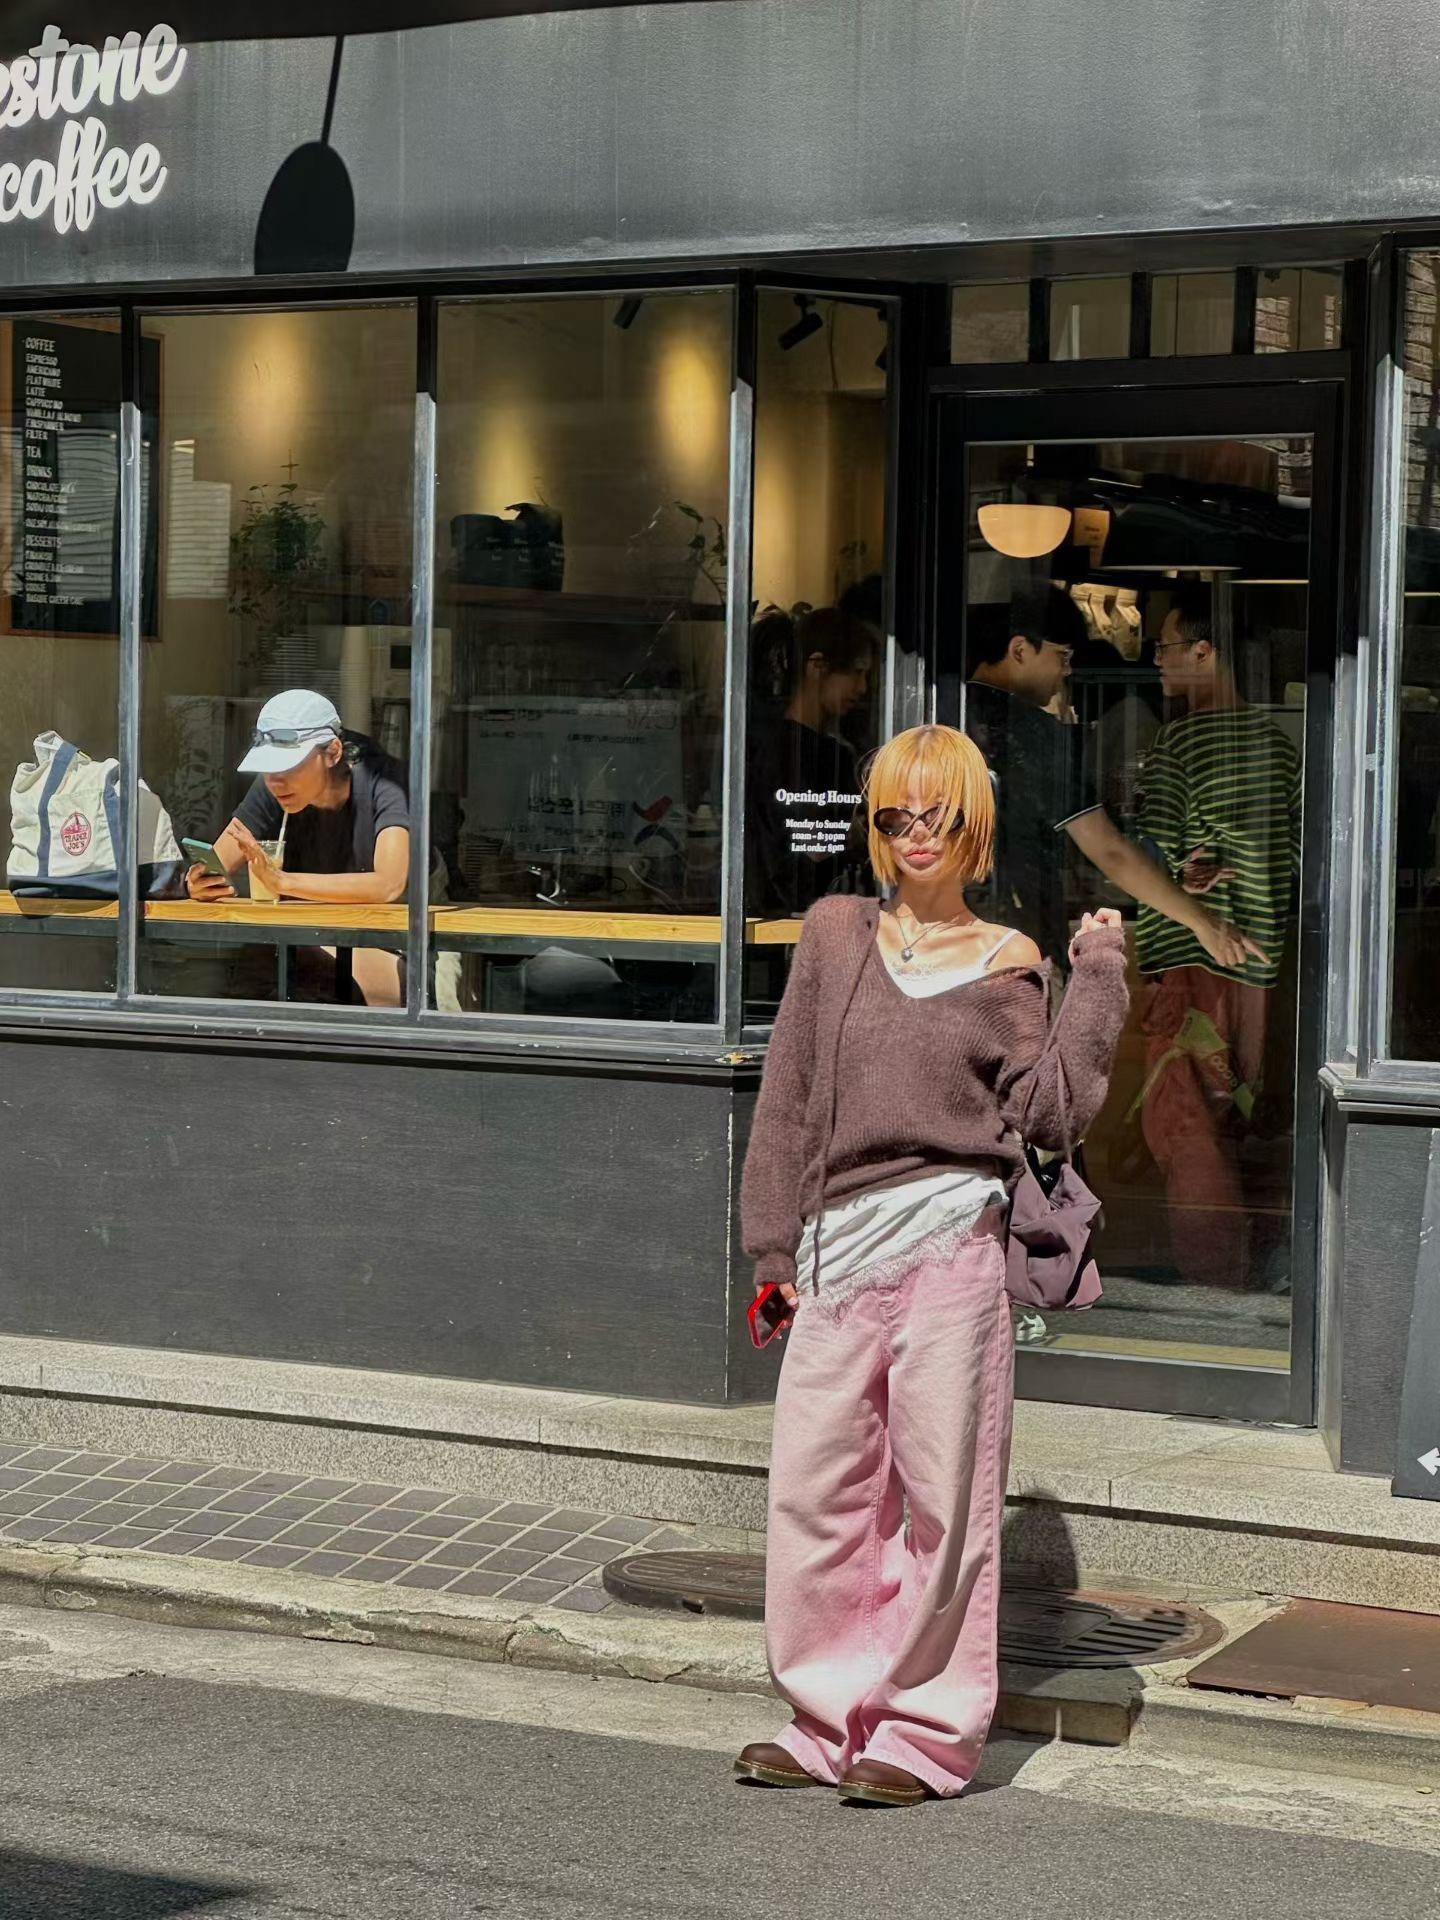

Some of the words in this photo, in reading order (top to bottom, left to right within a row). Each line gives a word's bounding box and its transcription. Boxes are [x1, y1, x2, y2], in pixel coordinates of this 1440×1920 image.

[0, 117, 168, 235] coffee
[25, 337, 56, 352] COFFEE
[26, 353, 58, 366] ESPRESSO
[26, 365, 61, 377] AMERICANO
[26, 375, 42, 386] FLAT
[42, 377, 62, 389] WHITE
[26, 386, 46, 397] LATTE
[26, 430, 48, 440] FILTER
[26, 445, 41, 458] TEA
[26, 465, 52, 478] DRINKS
[26, 535, 62, 548] DESSERTS
[776, 788, 826, 806] Opening
[827, 790, 862, 804] Hours
[785, 818, 815, 830] Monday
[816, 820, 823, 828] to
[824, 820, 851, 831] Sunday
[65, 832, 87, 843] TRADER
[792, 832, 811, 840] 10am
[817, 832, 845, 842] 8:30pm
[68, 840, 84, 850] JOE'S
[791, 843, 807, 852] Last
[807, 843, 826, 852] order
[827, 844, 844, 853] 8pm
